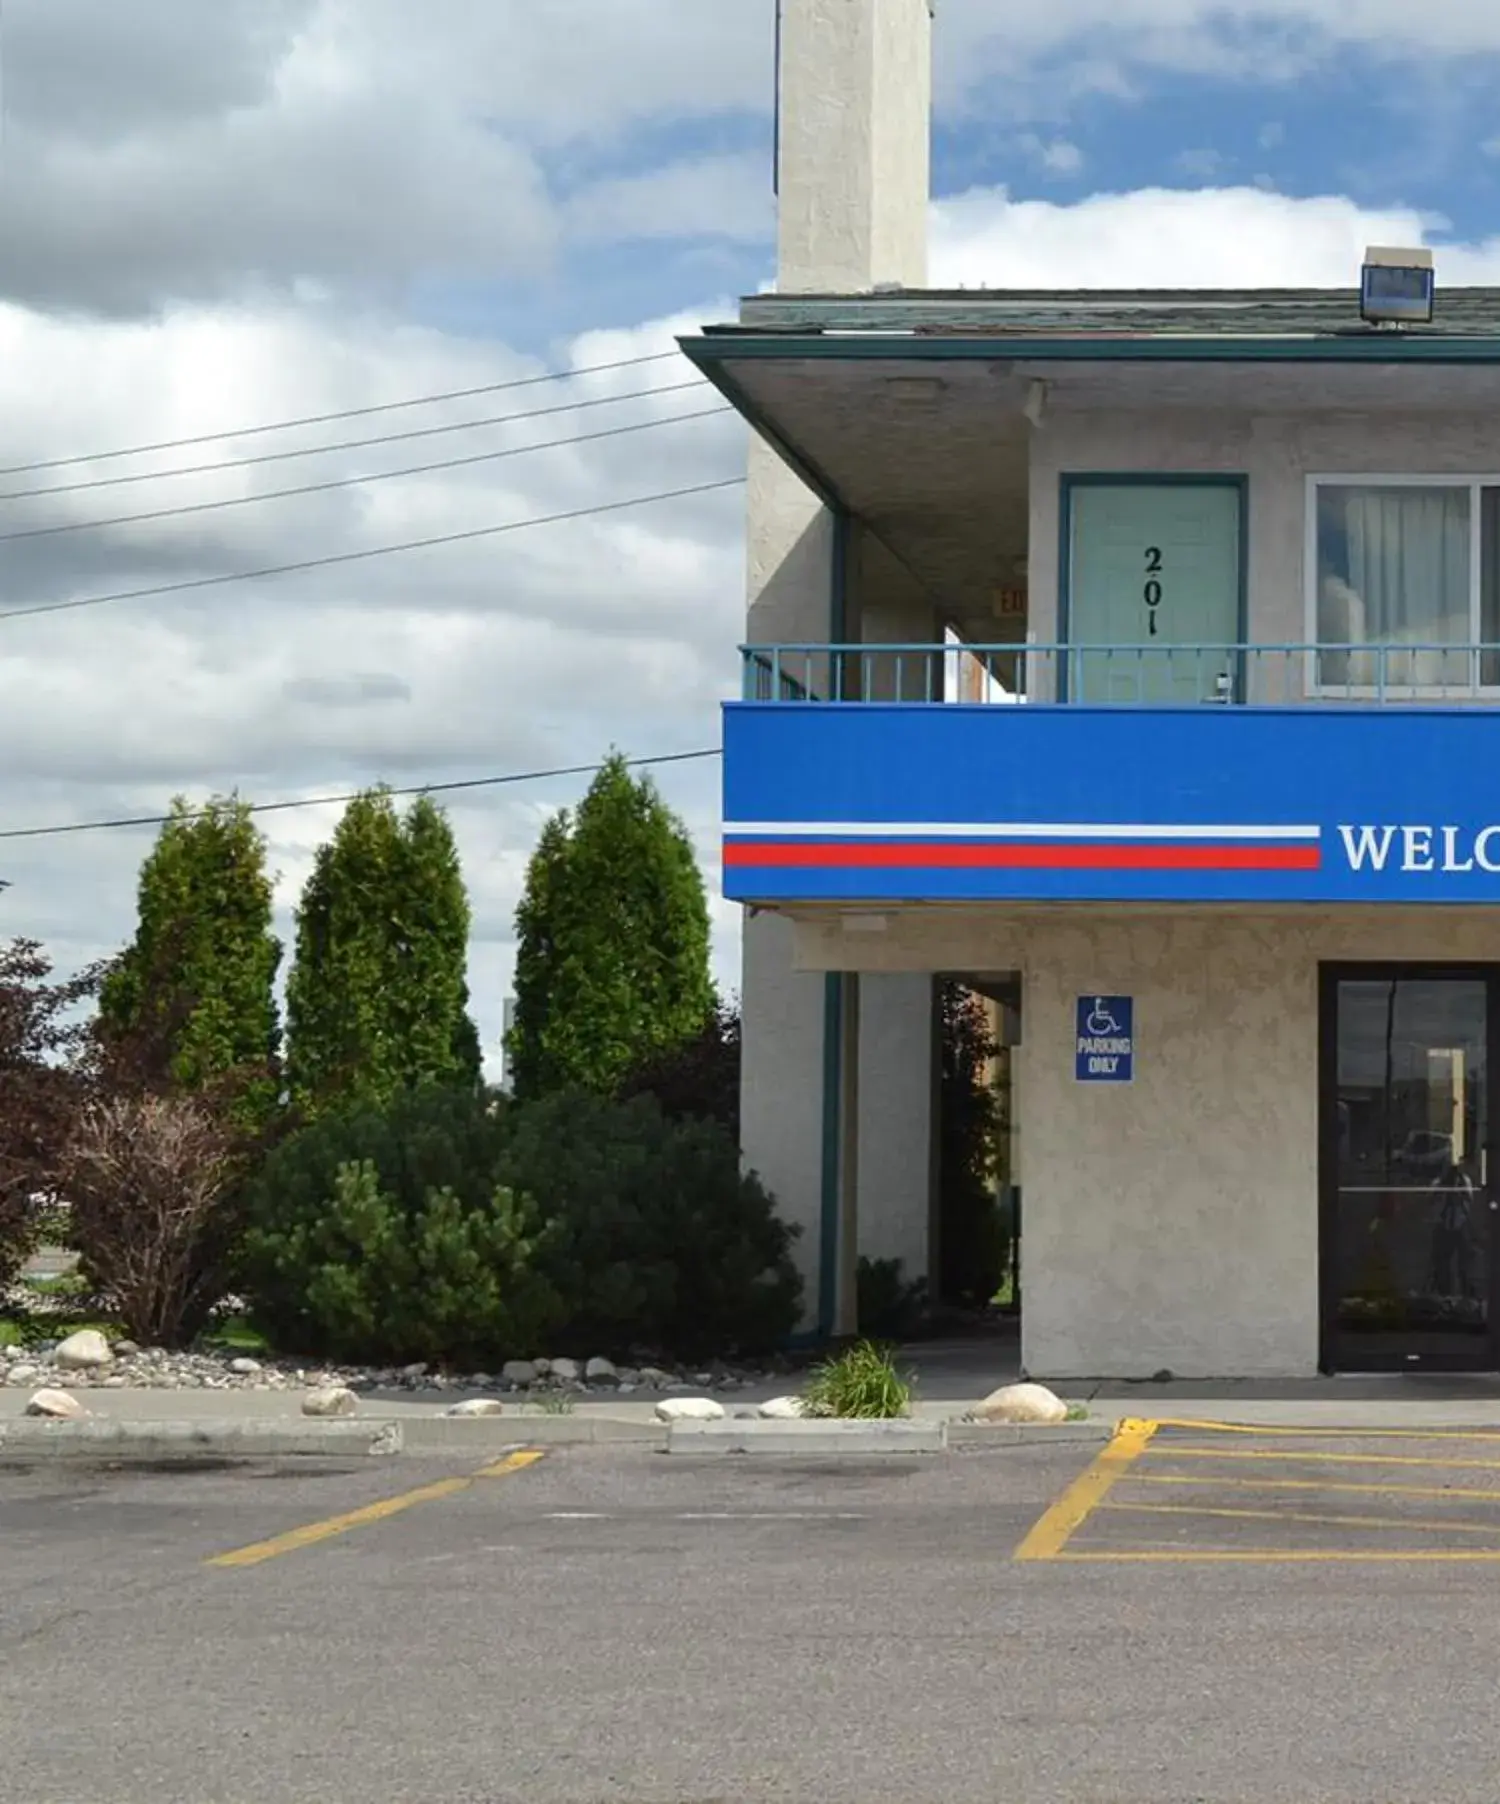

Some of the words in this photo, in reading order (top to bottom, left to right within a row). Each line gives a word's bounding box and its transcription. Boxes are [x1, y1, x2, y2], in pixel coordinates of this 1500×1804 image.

[1142, 546, 1163, 636] 201
[1077, 1037, 1131, 1054] PARKING
[1088, 1056, 1119, 1073] ONLY
